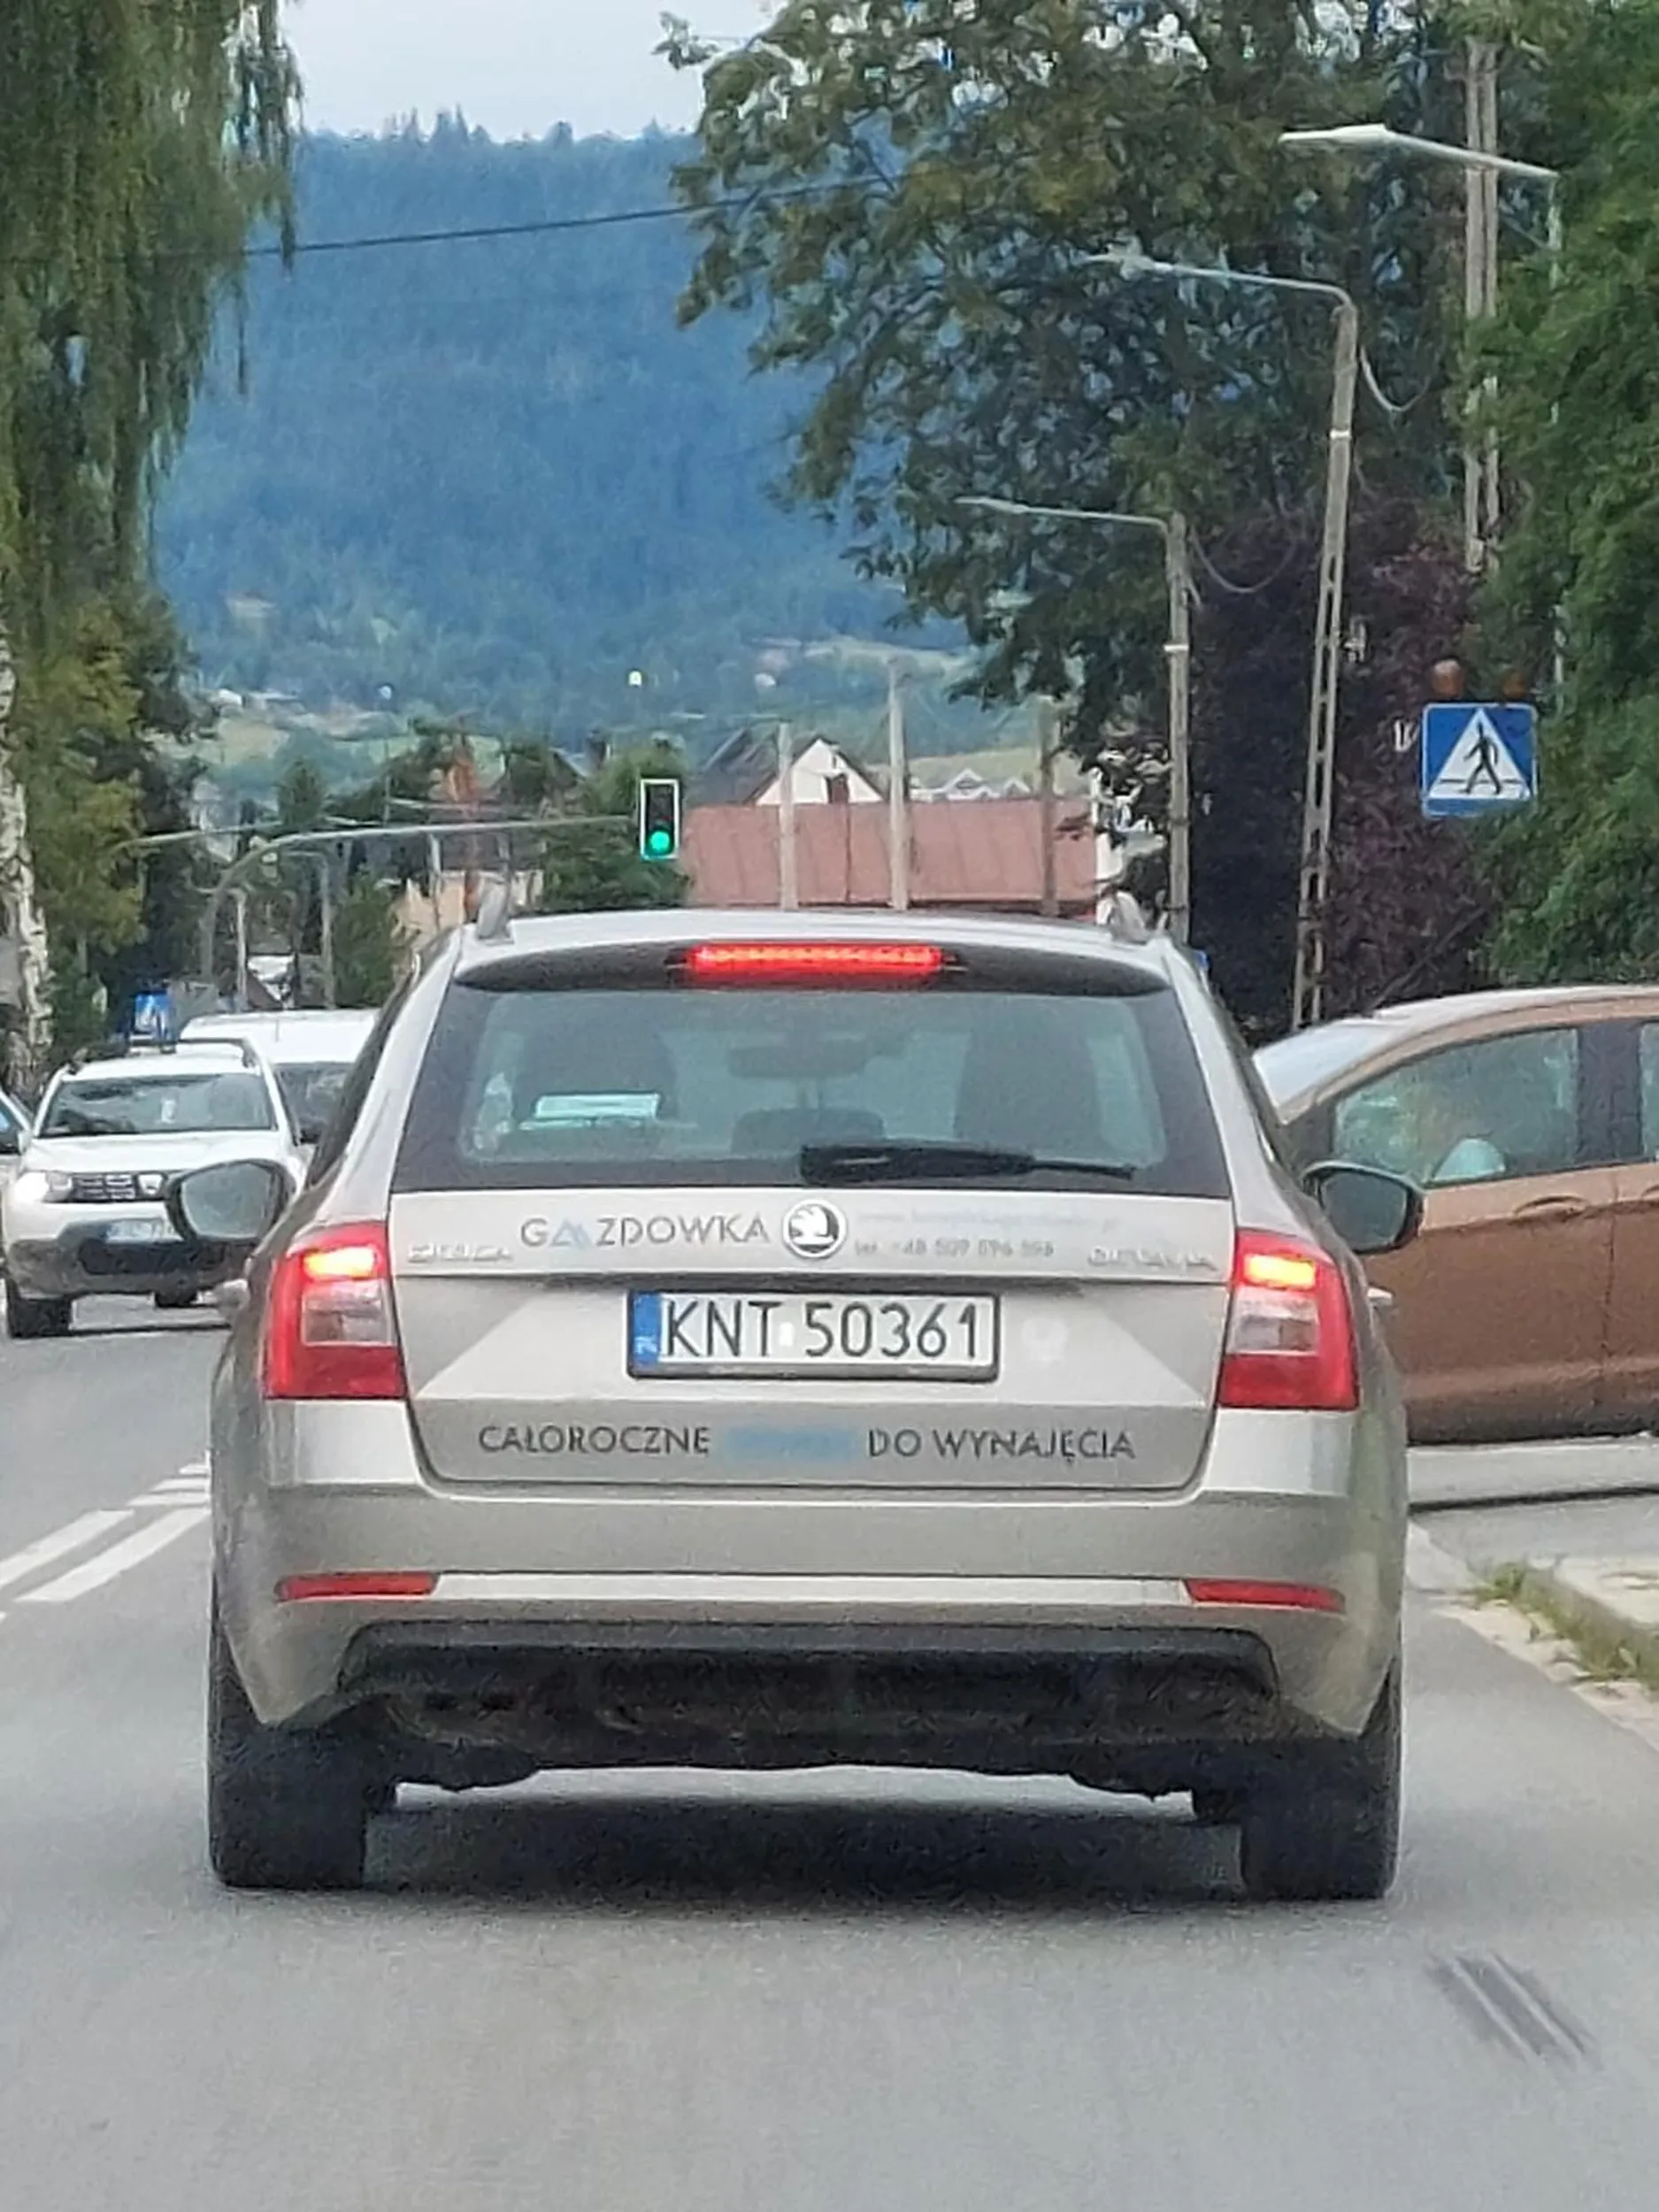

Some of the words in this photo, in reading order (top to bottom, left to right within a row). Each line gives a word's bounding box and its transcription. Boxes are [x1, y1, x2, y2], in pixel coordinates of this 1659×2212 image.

[665, 1300, 782, 1357] KNT
[804, 1301, 977, 1358] 50361
[478, 1425, 710, 1454] CAŁOROCZNE
[869, 1427, 922, 1458] DO
[932, 1426, 1135, 1466] WYNAJĘCIA
